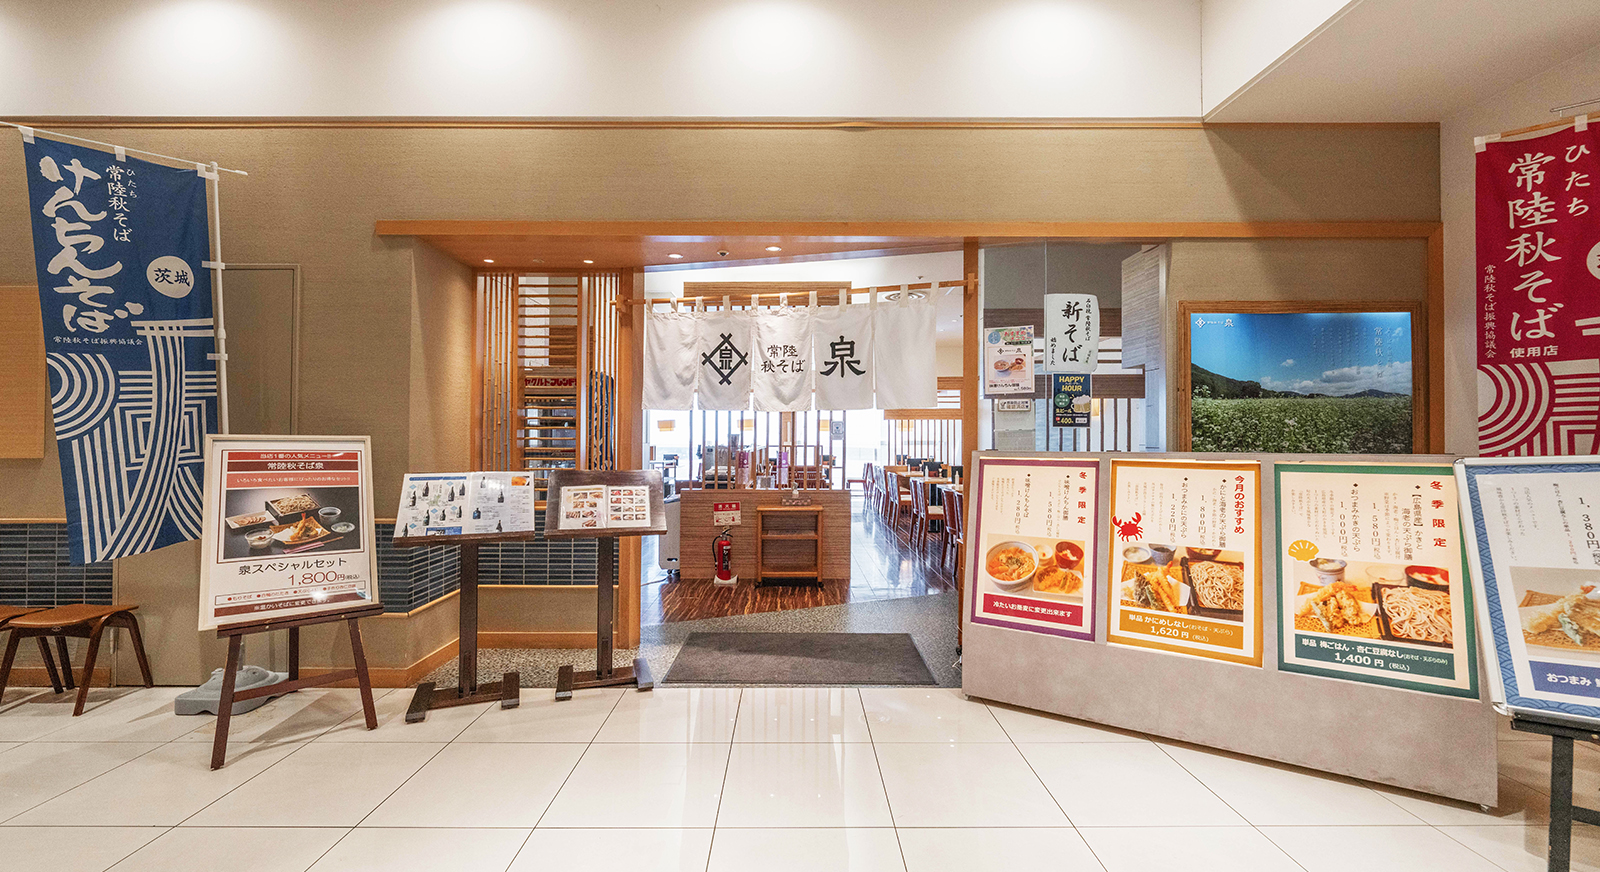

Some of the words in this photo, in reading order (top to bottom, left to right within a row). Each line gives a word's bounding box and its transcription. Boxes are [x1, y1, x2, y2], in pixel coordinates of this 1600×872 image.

[126, 168, 138, 199] ひたち
[1564, 144, 1590, 217] ひたち
[105, 165, 132, 243] 常陸秋そば
[39, 155, 144, 333] けんちんそば
[1504, 152, 1564, 341] 常陸秋そば
[153, 267, 191, 288] 茨城
[1061, 301, 1083, 362] 新そば
[767, 344, 798, 358] 常陸
[819, 335, 866, 378] 泉
[1509, 344, 1559, 359] 使用店
[760, 359, 806, 373] 秋そば
[267, 462, 324, 470] 常陸秋そば泉
[1077, 471, 1088, 524] 冬季限定
[1233, 475, 1245, 534] 今月のおすすめ
[1430, 480, 1447, 548] 冬季限定
[238, 557, 347, 576] 泉スペシャルセット
[993, 600, 1072, 618] 冷たいお蕎麦に変更出来ます
[1128, 614, 1143, 622] 単品
[1150, 626, 1179, 637] 1,620
[1181, 631, 1189, 639] 円
[1302, 638, 1317, 647] 単品
[1334, 652, 1371, 665] 1,400
[1374, 659, 1384, 667] 円
[1546, 672, 1591, 687] おつまみ
